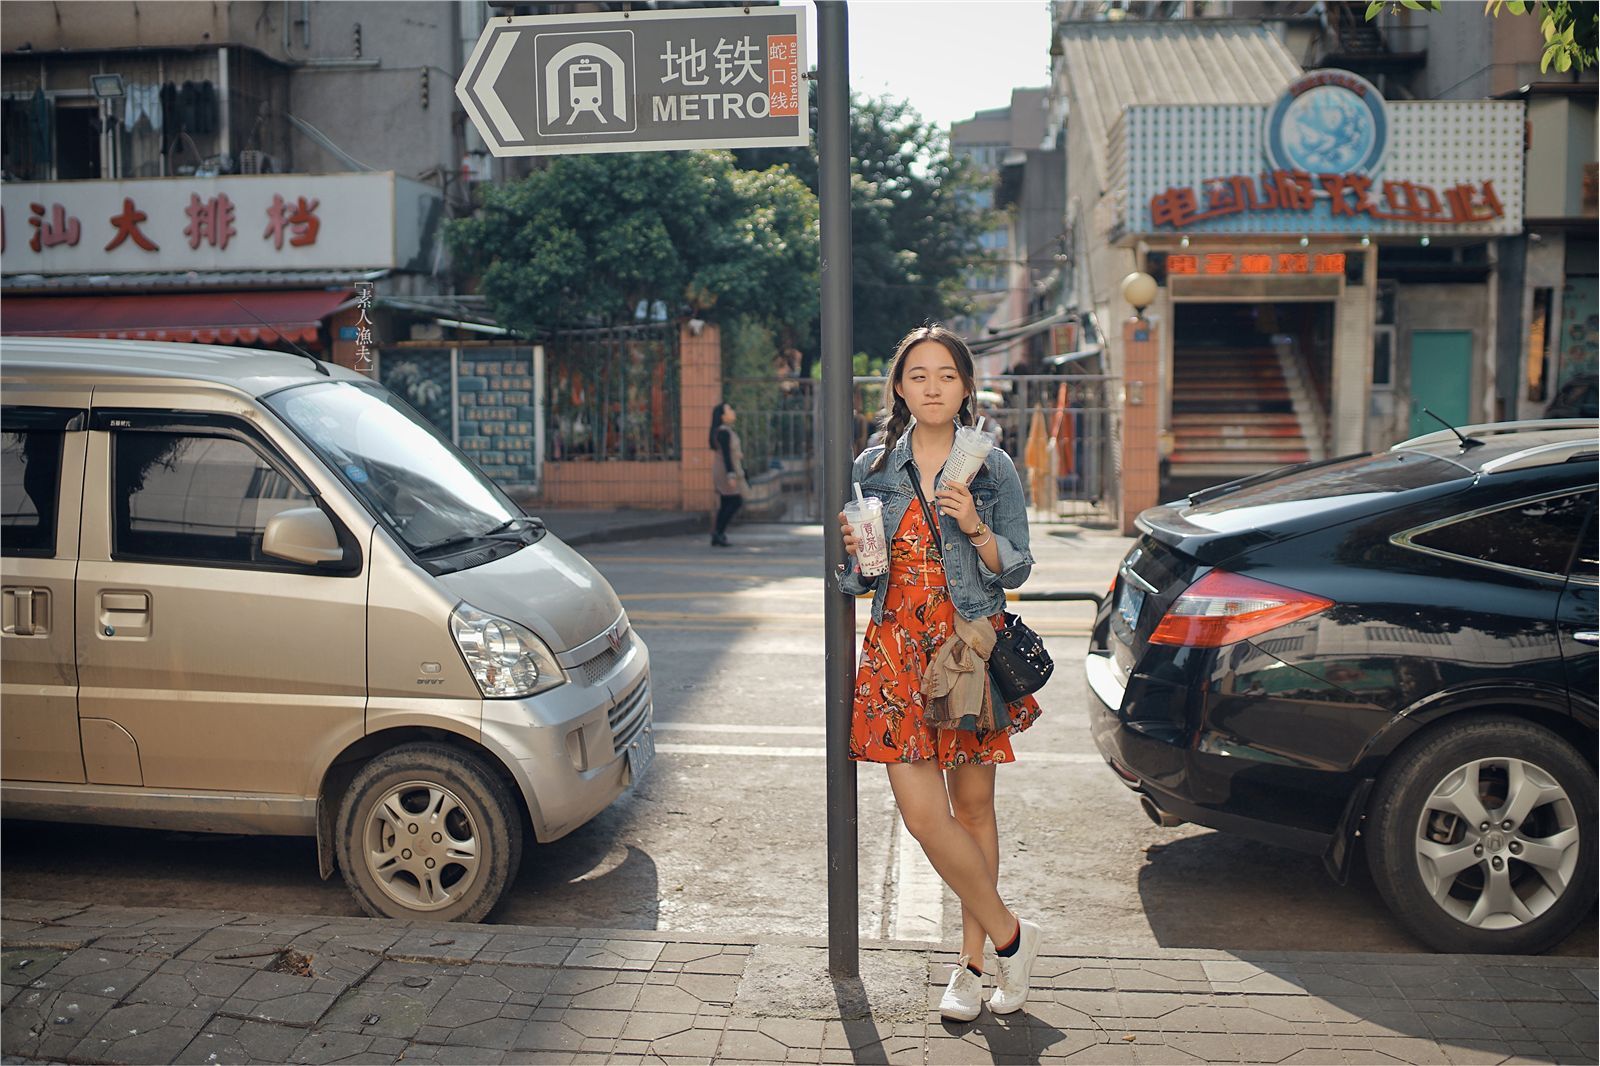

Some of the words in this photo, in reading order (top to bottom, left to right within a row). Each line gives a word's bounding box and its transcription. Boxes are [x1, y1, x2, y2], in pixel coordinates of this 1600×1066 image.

[660, 36, 764, 86] 地铁
[770, 42, 788, 109] 蛇口线
[789, 42, 797, 65] Line
[652, 92, 770, 121] METRO
[789, 67, 798, 108] Shekou
[1, 192, 321, 253] 汕大排档
[1151, 168, 1504, 227] 电动游戏中心
